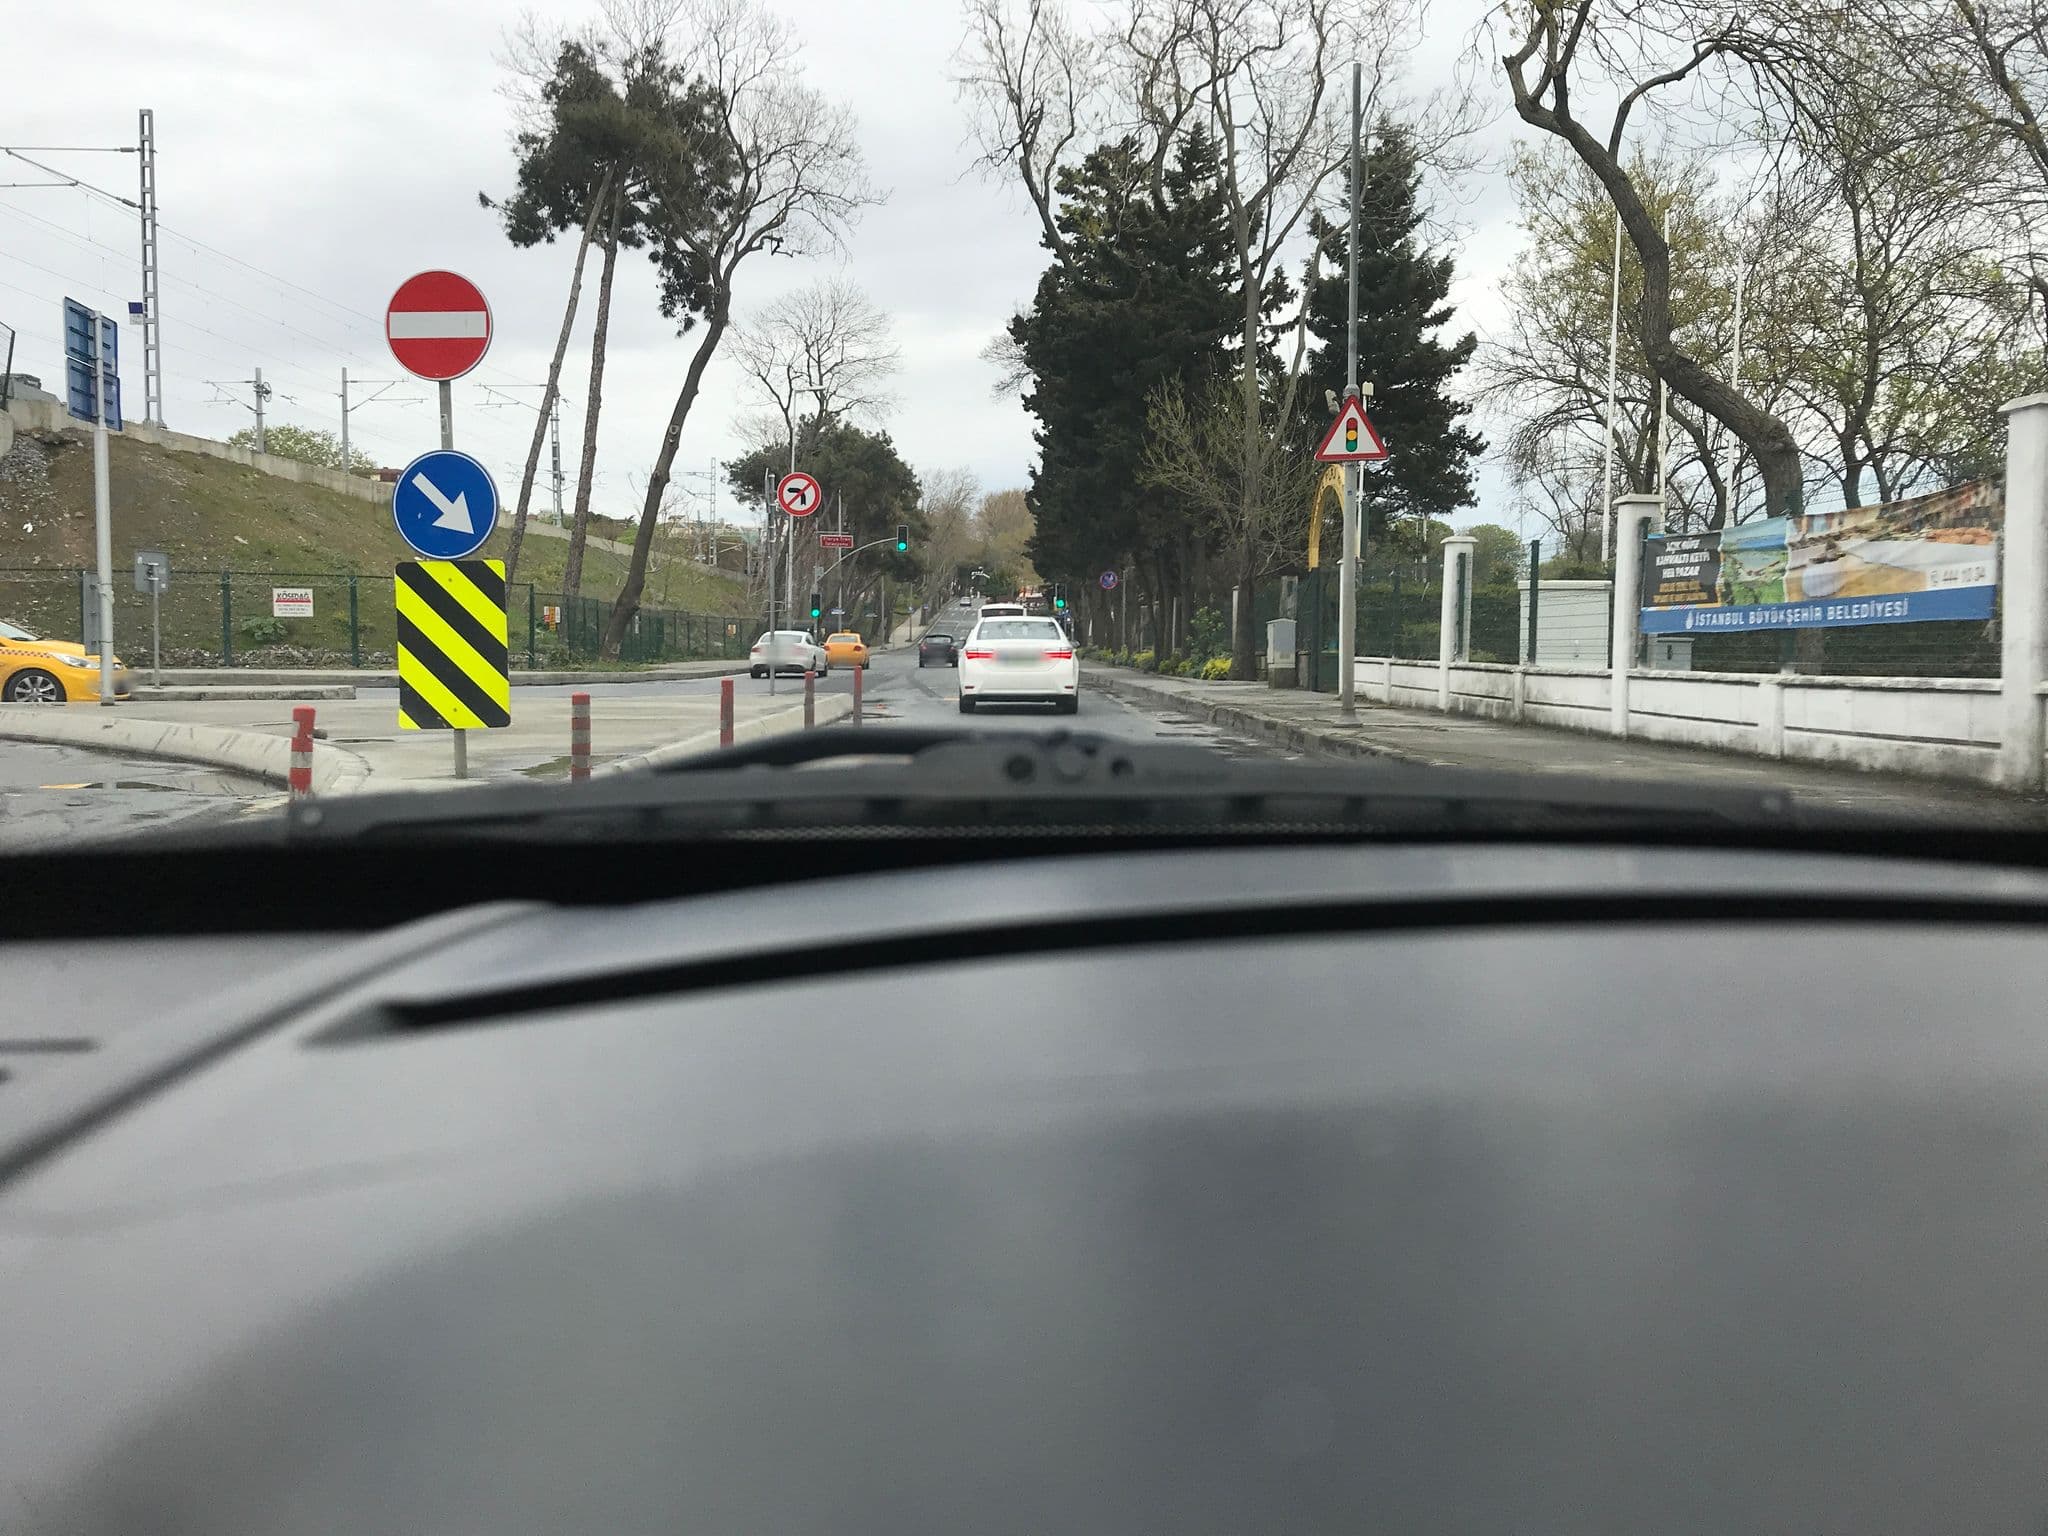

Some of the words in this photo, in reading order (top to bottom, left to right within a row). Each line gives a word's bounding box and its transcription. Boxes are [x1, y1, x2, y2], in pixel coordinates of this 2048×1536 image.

[1675, 565, 1700, 578] PAZAR
[1695, 611, 1745, 626] İSTANBUL
[1748, 604, 1823, 626] BÜYÜKŞEHİR
[1827, 597, 1910, 620] BELEDİYESİ
